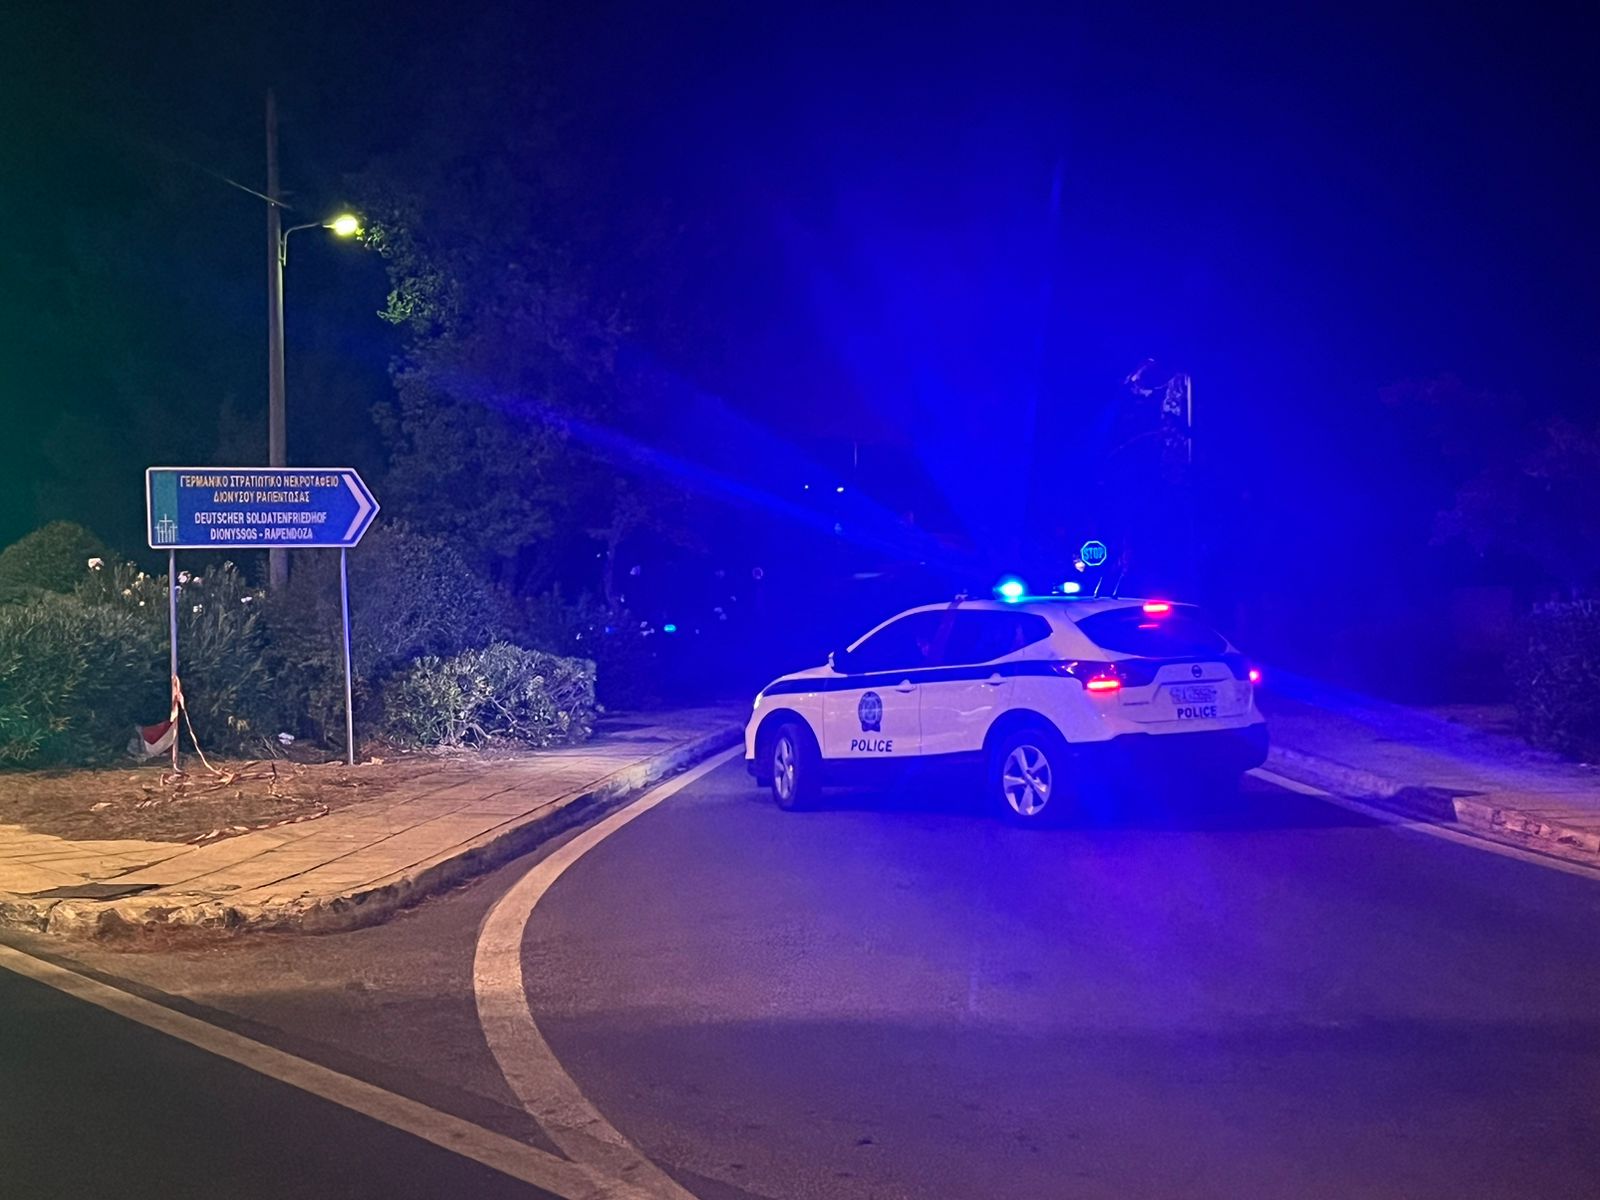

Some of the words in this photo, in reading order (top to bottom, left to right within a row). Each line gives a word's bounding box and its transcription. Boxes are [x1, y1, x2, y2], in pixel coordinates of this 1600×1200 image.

[194, 512, 245, 525] DEUTSCHER
[246, 512, 327, 524] SOLDATENFRIEDHOF
[210, 528, 258, 540] DIONYSSOS
[264, 528, 314, 540] RAPENDOZA
[1083, 547, 1104, 560] STOP
[1177, 706, 1217, 719] POLICE
[851, 739, 893, 753] POLICE
